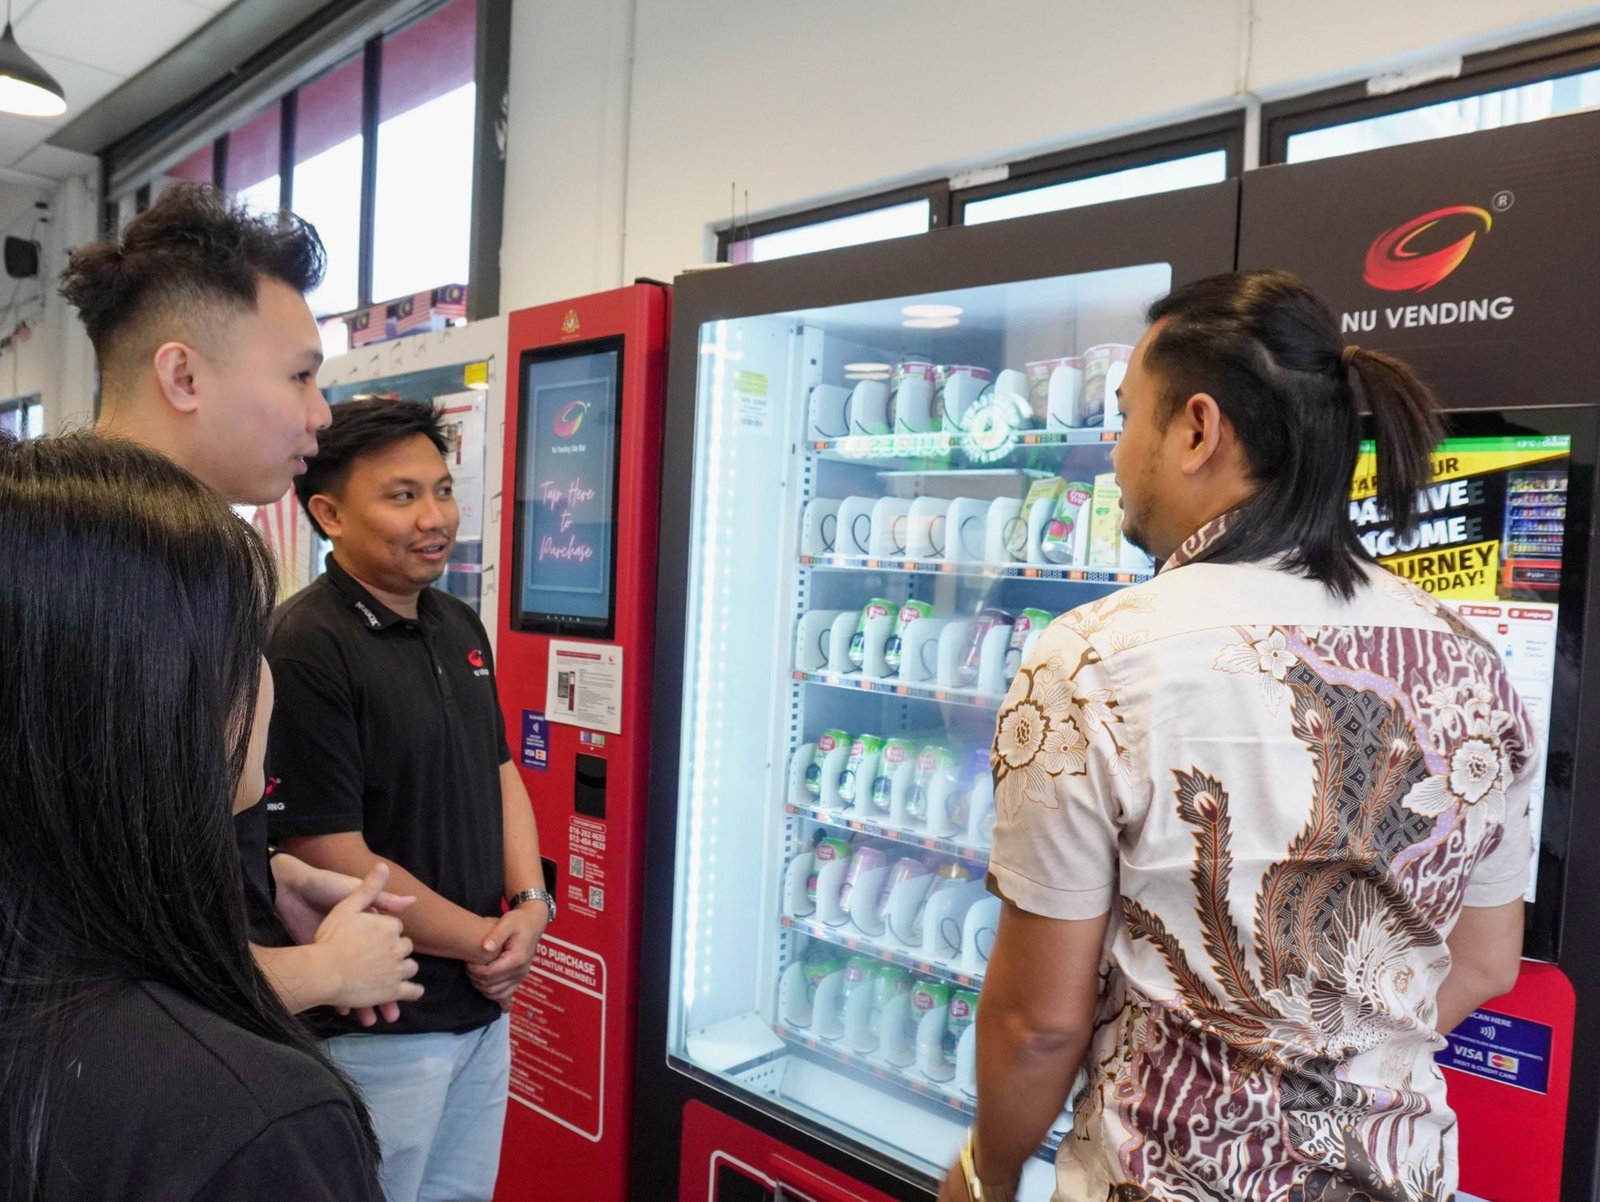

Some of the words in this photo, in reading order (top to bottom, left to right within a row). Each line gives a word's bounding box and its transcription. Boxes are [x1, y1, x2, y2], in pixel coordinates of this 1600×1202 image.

[1341, 309, 1377, 333] NU
[1384, 296, 1515, 329] VENDING
[1431, 457, 1459, 477] UR
[540, 481, 562, 511] Tap
[568, 477, 595, 506] Here
[560, 510, 573, 532] to
[1357, 515, 1468, 558] NCOME
[539, 535, 593, 566] Purchase
[1414, 571, 1486, 595] ODAY!
[536, 943, 548, 957] TO
[548, 948, 596, 976] PURCHASE
[541, 958, 565, 974] UNTUK
[565, 968, 597, 987] MEMBELI
[1491, 1016, 1512, 1028] HERE
[1453, 1044, 1484, 1062] VISA
[1453, 1058, 1471, 1068] DEBIT
[1477, 1064, 1498, 1076] CREDIT
[1498, 1071, 1517, 1081] CARD
